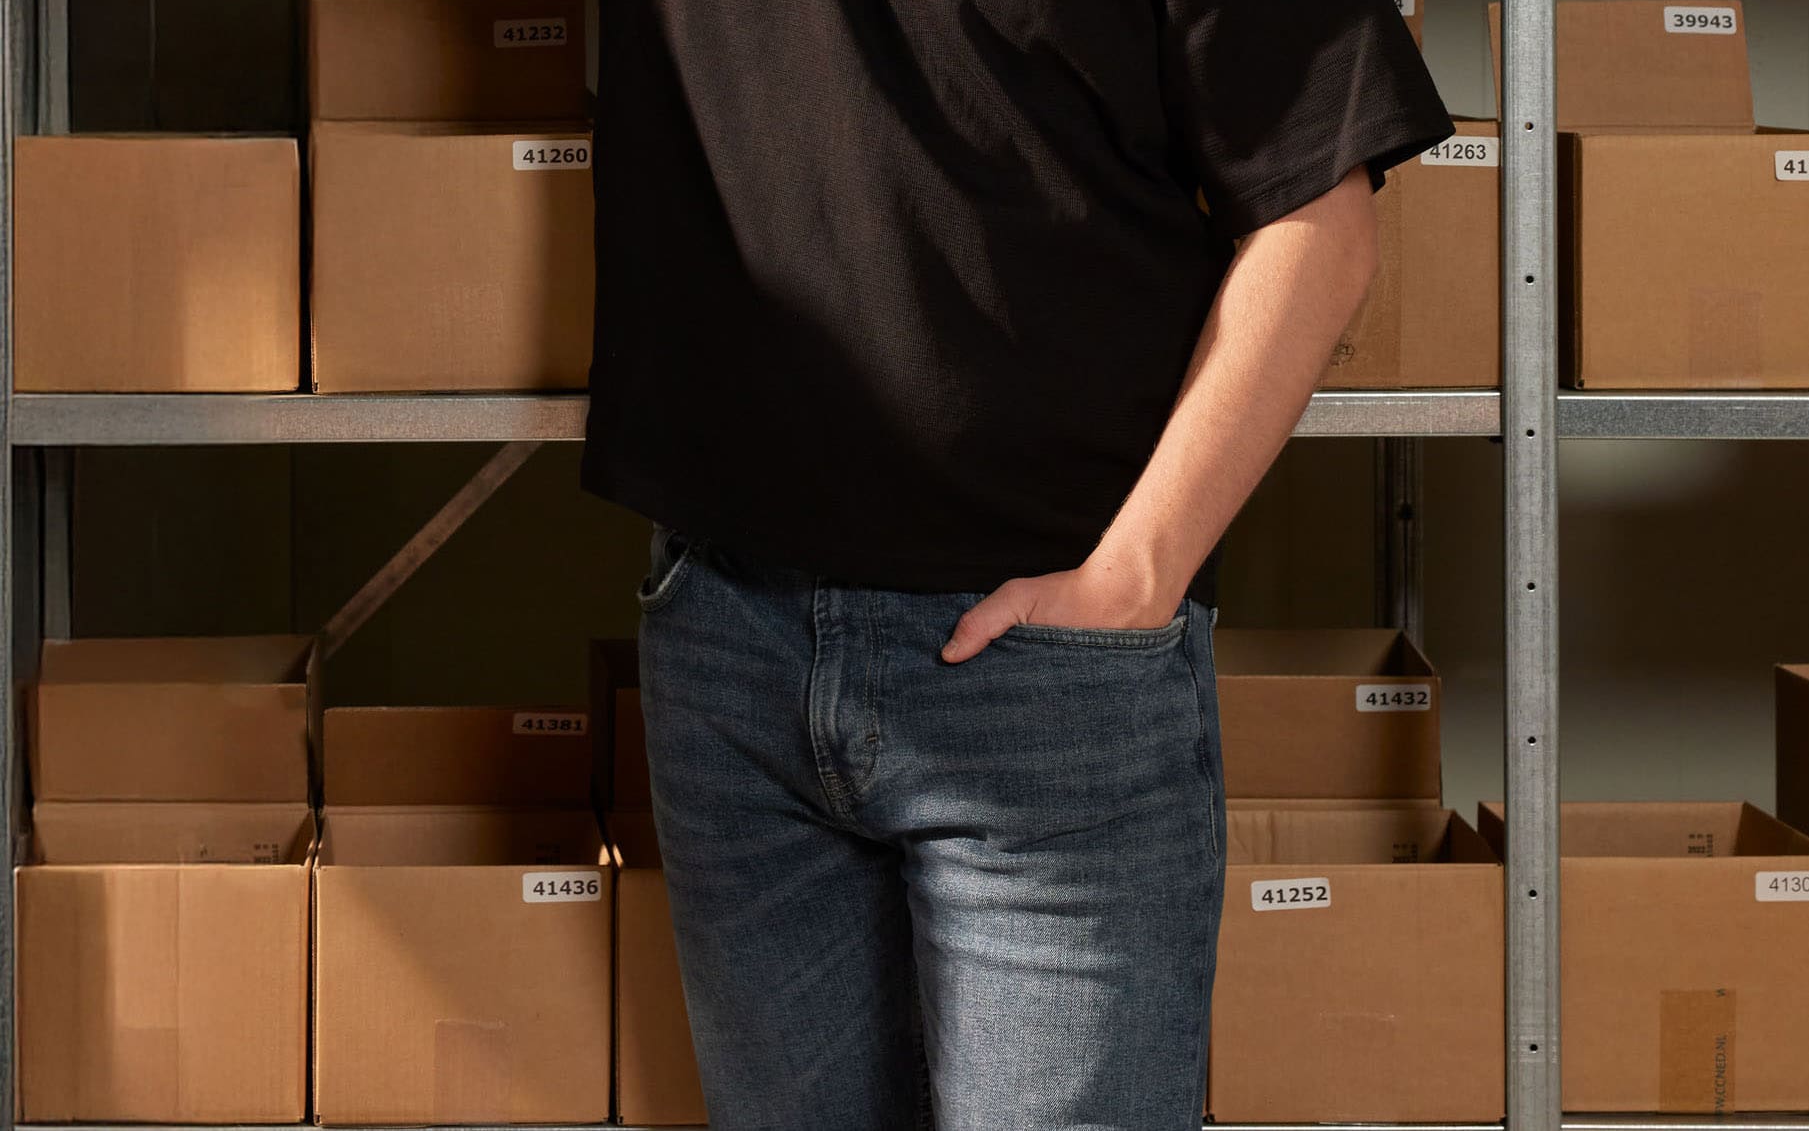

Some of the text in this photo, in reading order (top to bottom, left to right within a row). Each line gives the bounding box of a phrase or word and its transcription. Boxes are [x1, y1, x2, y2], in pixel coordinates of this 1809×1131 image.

[1674, 14, 1733, 29] 39943
[503, 25, 564, 41] 41232
[523, 148, 588, 164] 41260
[1429, 143, 1487, 160] 41263
[1366, 691, 1428, 706] 41432
[521, 718, 583, 732] 41381
[532, 879, 598, 896] 41436
[1261, 886, 1328, 904] 41252
